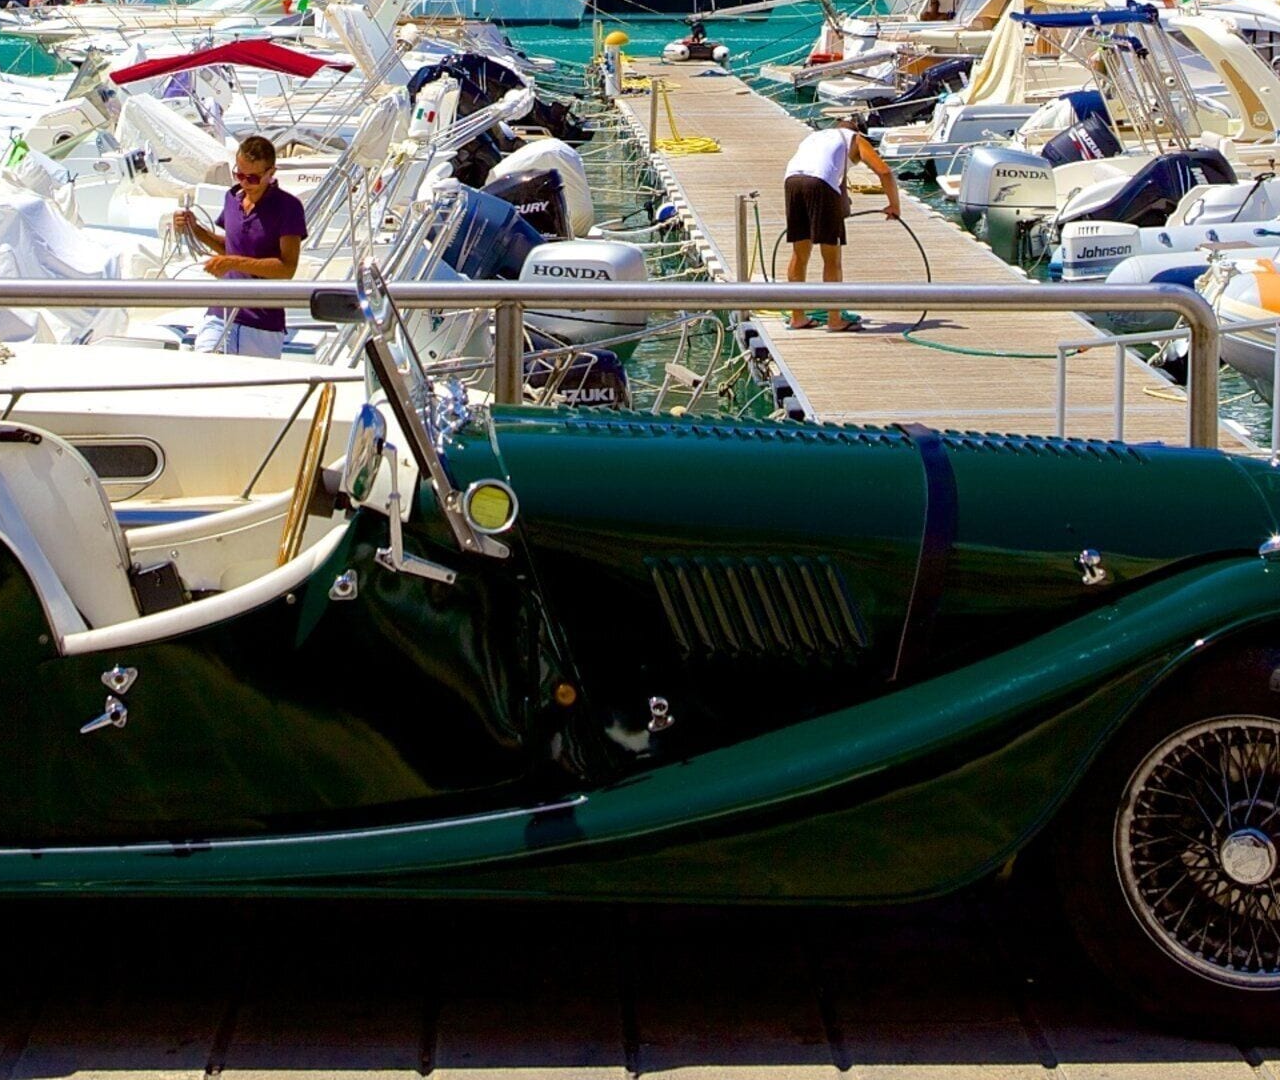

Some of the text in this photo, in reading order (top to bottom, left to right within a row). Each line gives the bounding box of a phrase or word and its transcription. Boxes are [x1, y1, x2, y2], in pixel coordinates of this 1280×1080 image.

[297, 173, 327, 183] Prin
[996, 168, 1049, 180] HONDA
[514, 200, 550, 215] CURY
[1077, 244, 1132, 259] Johnson
[532, 264, 613, 281] HONDA
